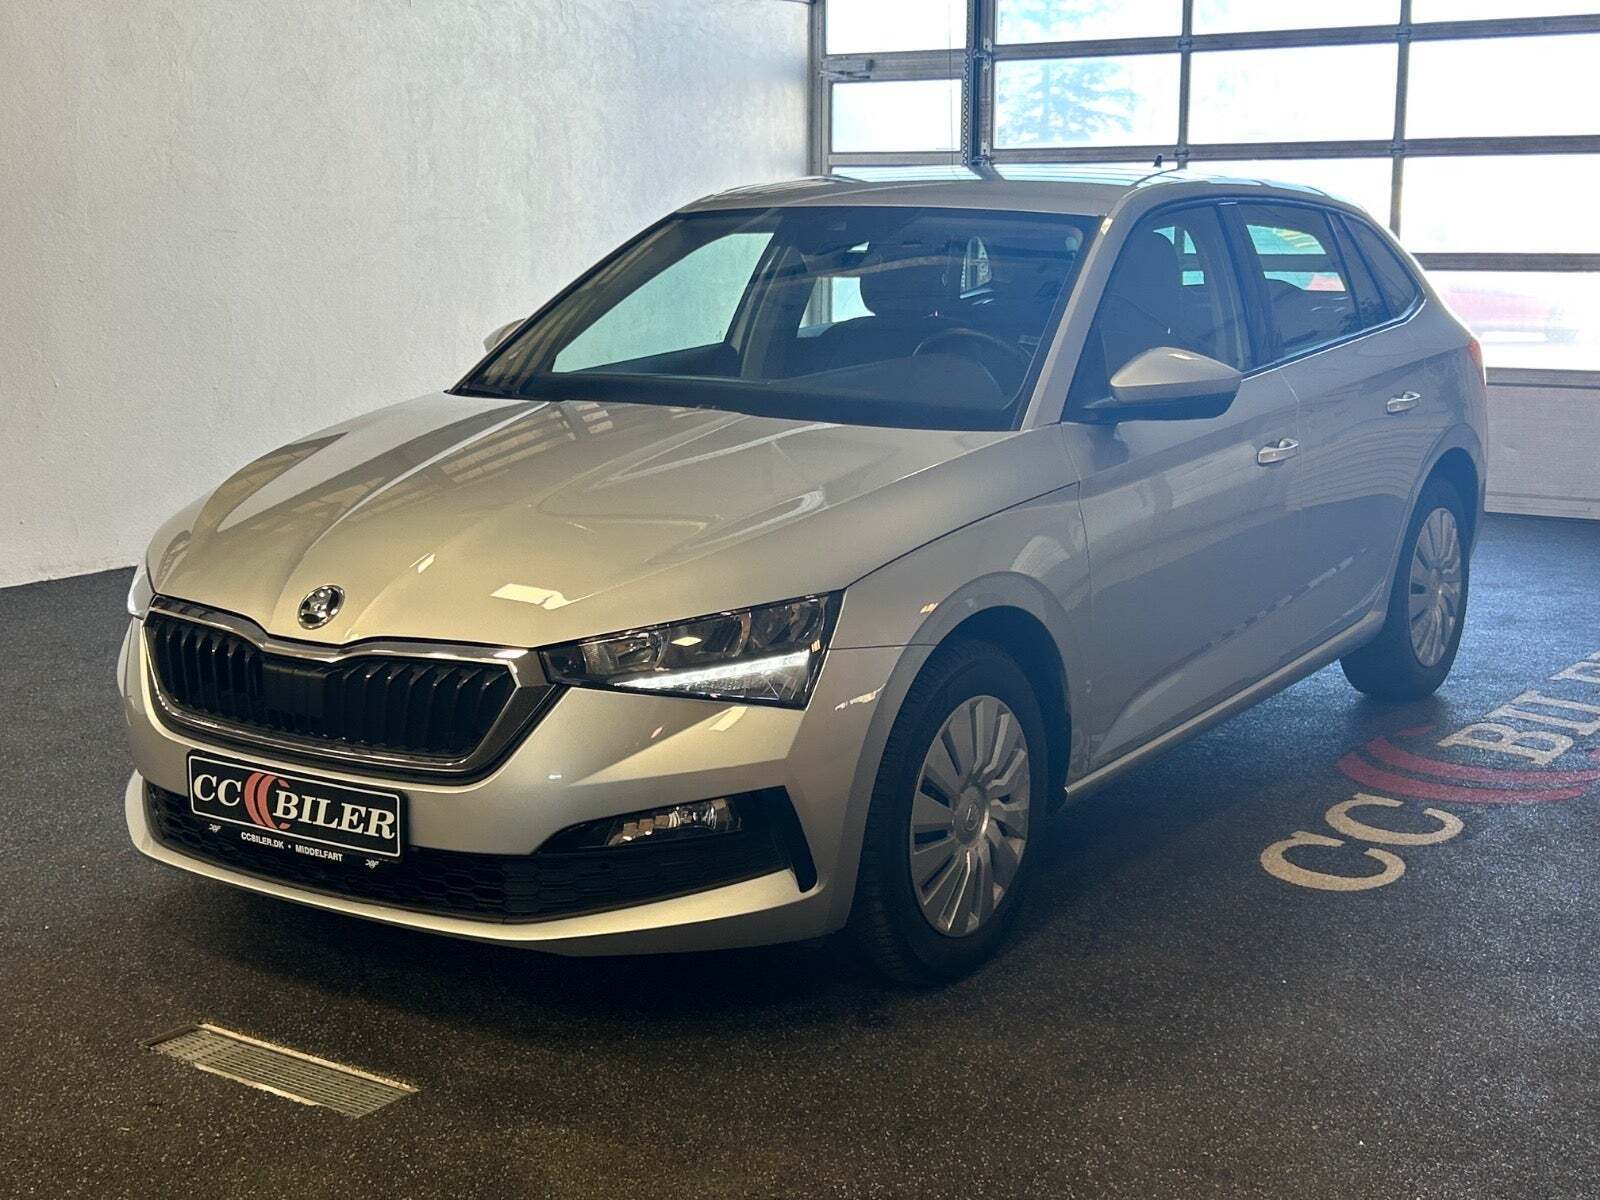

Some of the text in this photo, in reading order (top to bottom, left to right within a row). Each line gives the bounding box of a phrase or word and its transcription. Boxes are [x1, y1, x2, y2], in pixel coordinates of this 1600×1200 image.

[193, 774, 396, 840] CC BILER
[240, 831, 344, 862] CCBILER.DK MIDDELFART
[1260, 792, 1465, 892] CC
